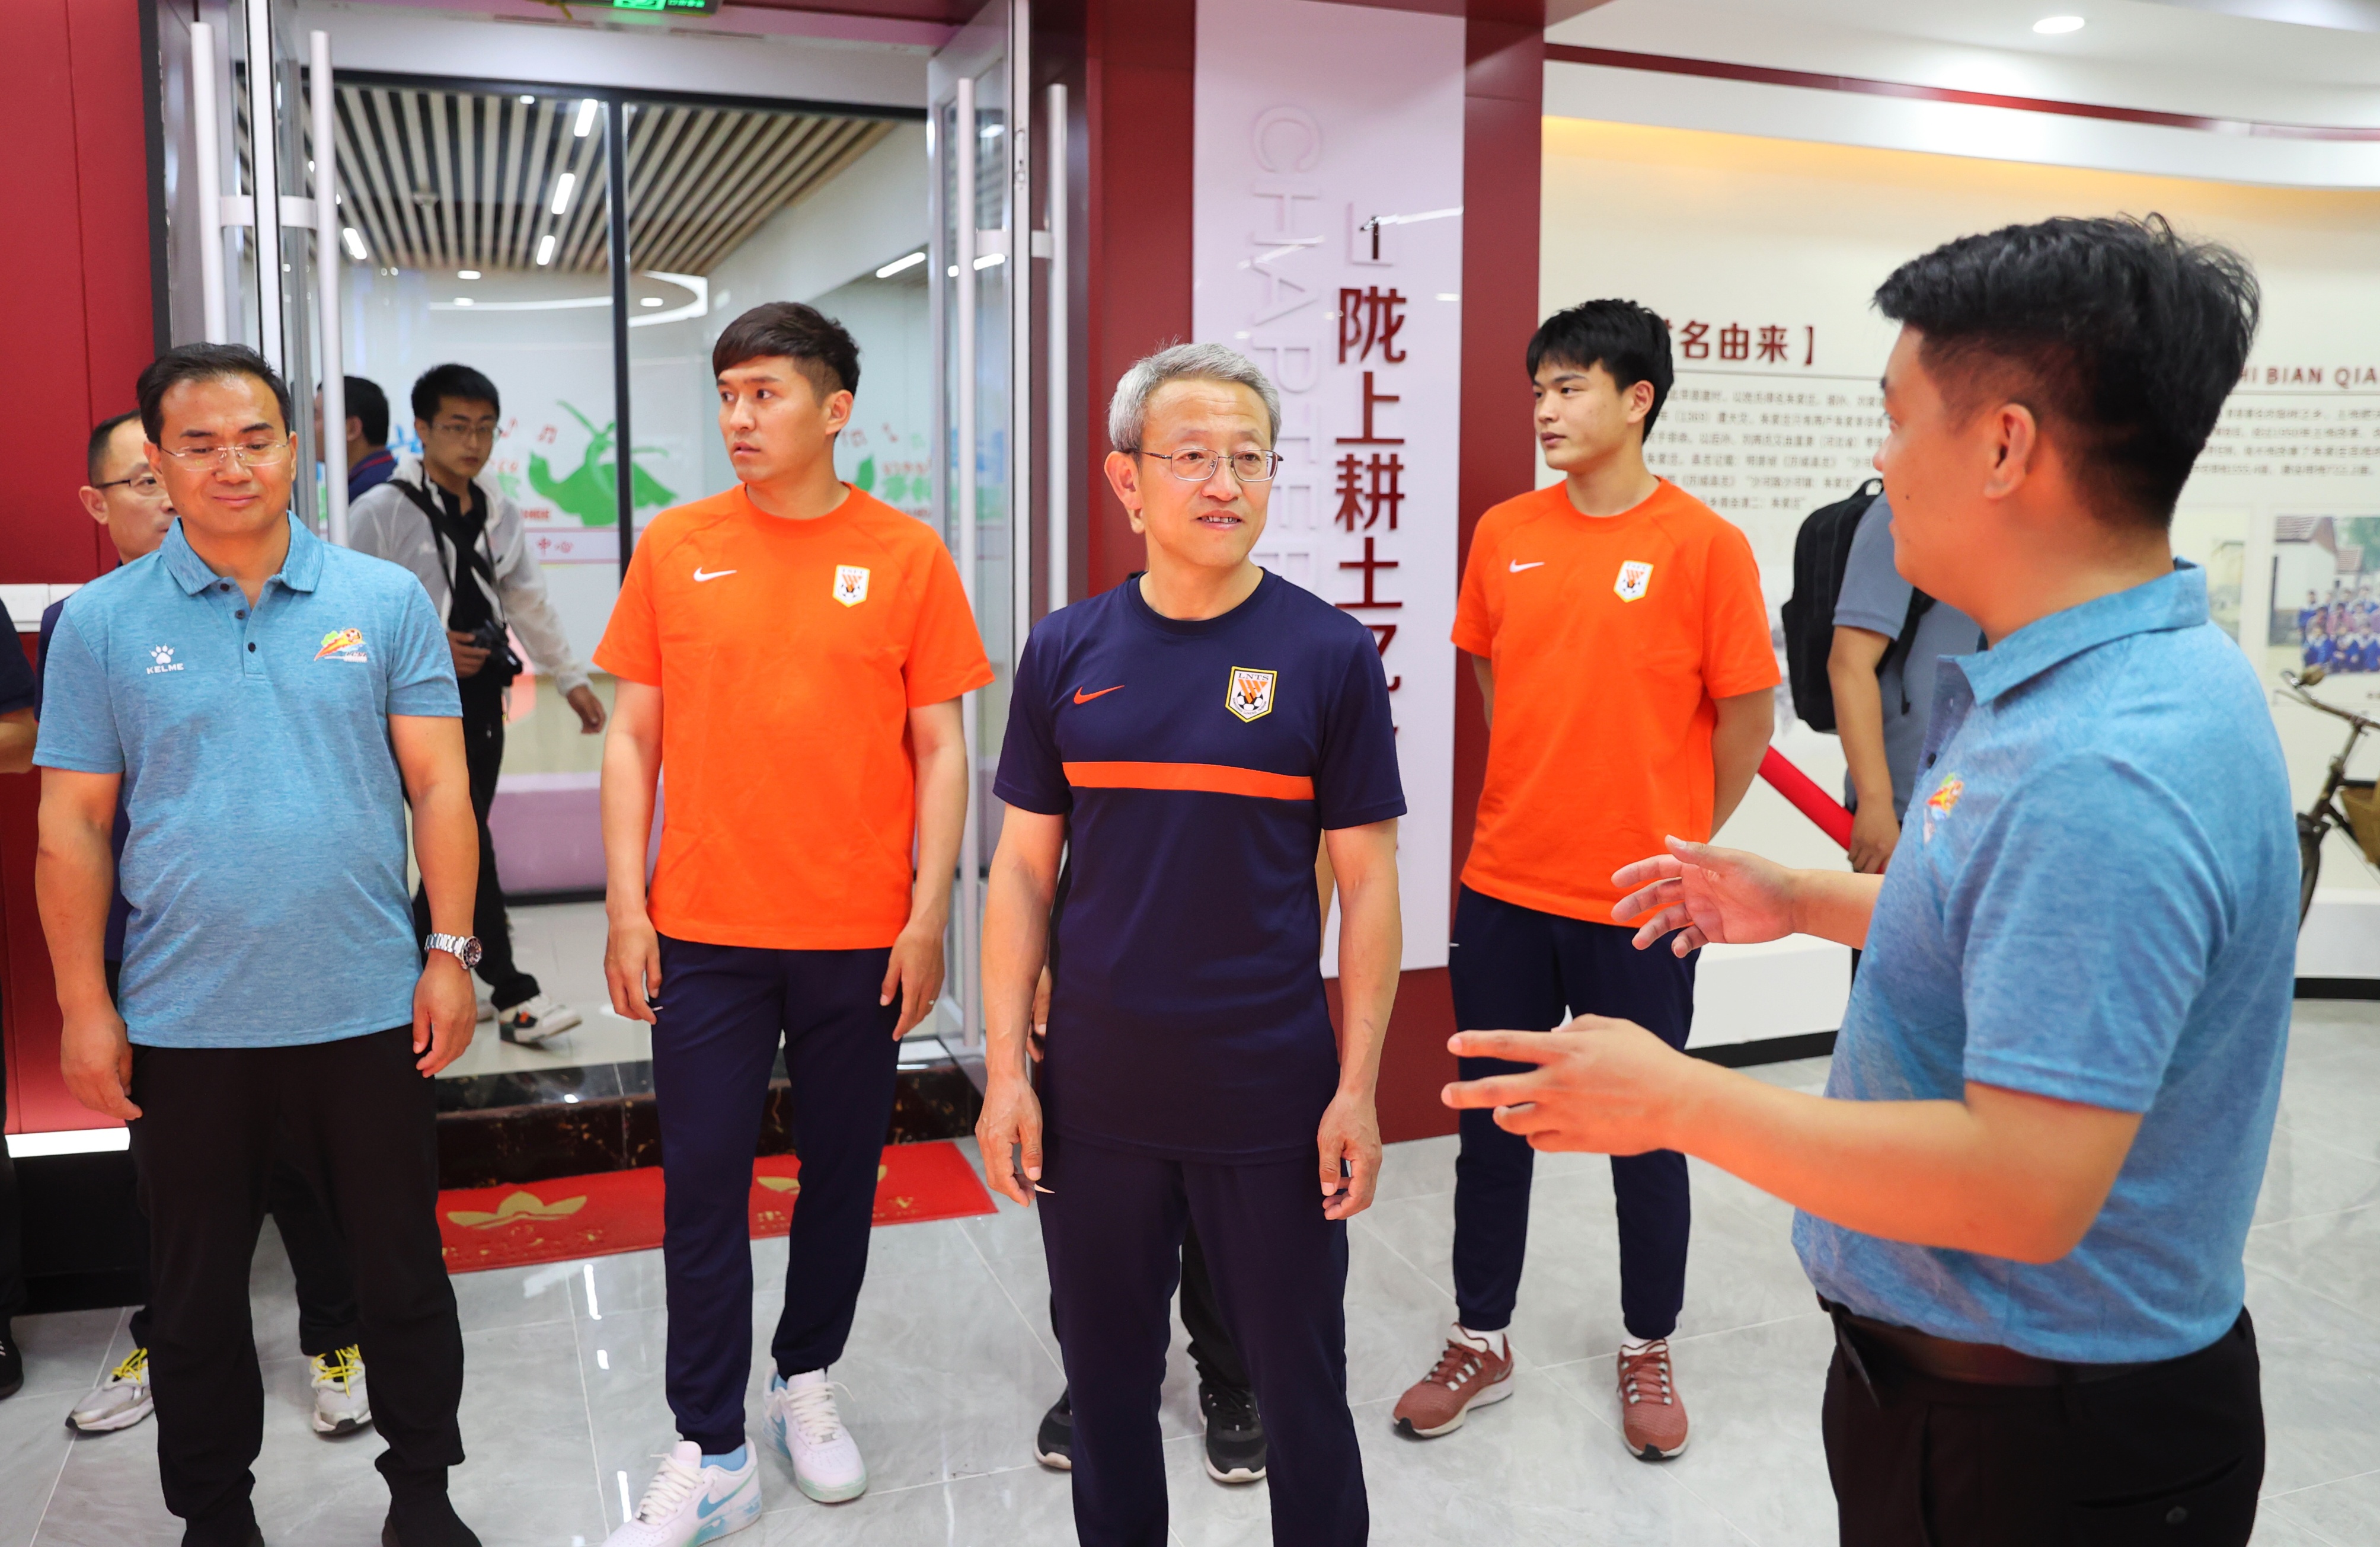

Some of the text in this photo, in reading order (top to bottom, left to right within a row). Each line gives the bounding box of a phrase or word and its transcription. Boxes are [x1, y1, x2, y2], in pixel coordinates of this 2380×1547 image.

[1663, 319, 1815, 366] 名由来】
[2267, 367, 2321, 384] BIAN
[1335, 286, 1407, 739] 陇上耕土
[146, 663, 184, 675] KELME
[1238, 673, 1269, 681] LNTS
